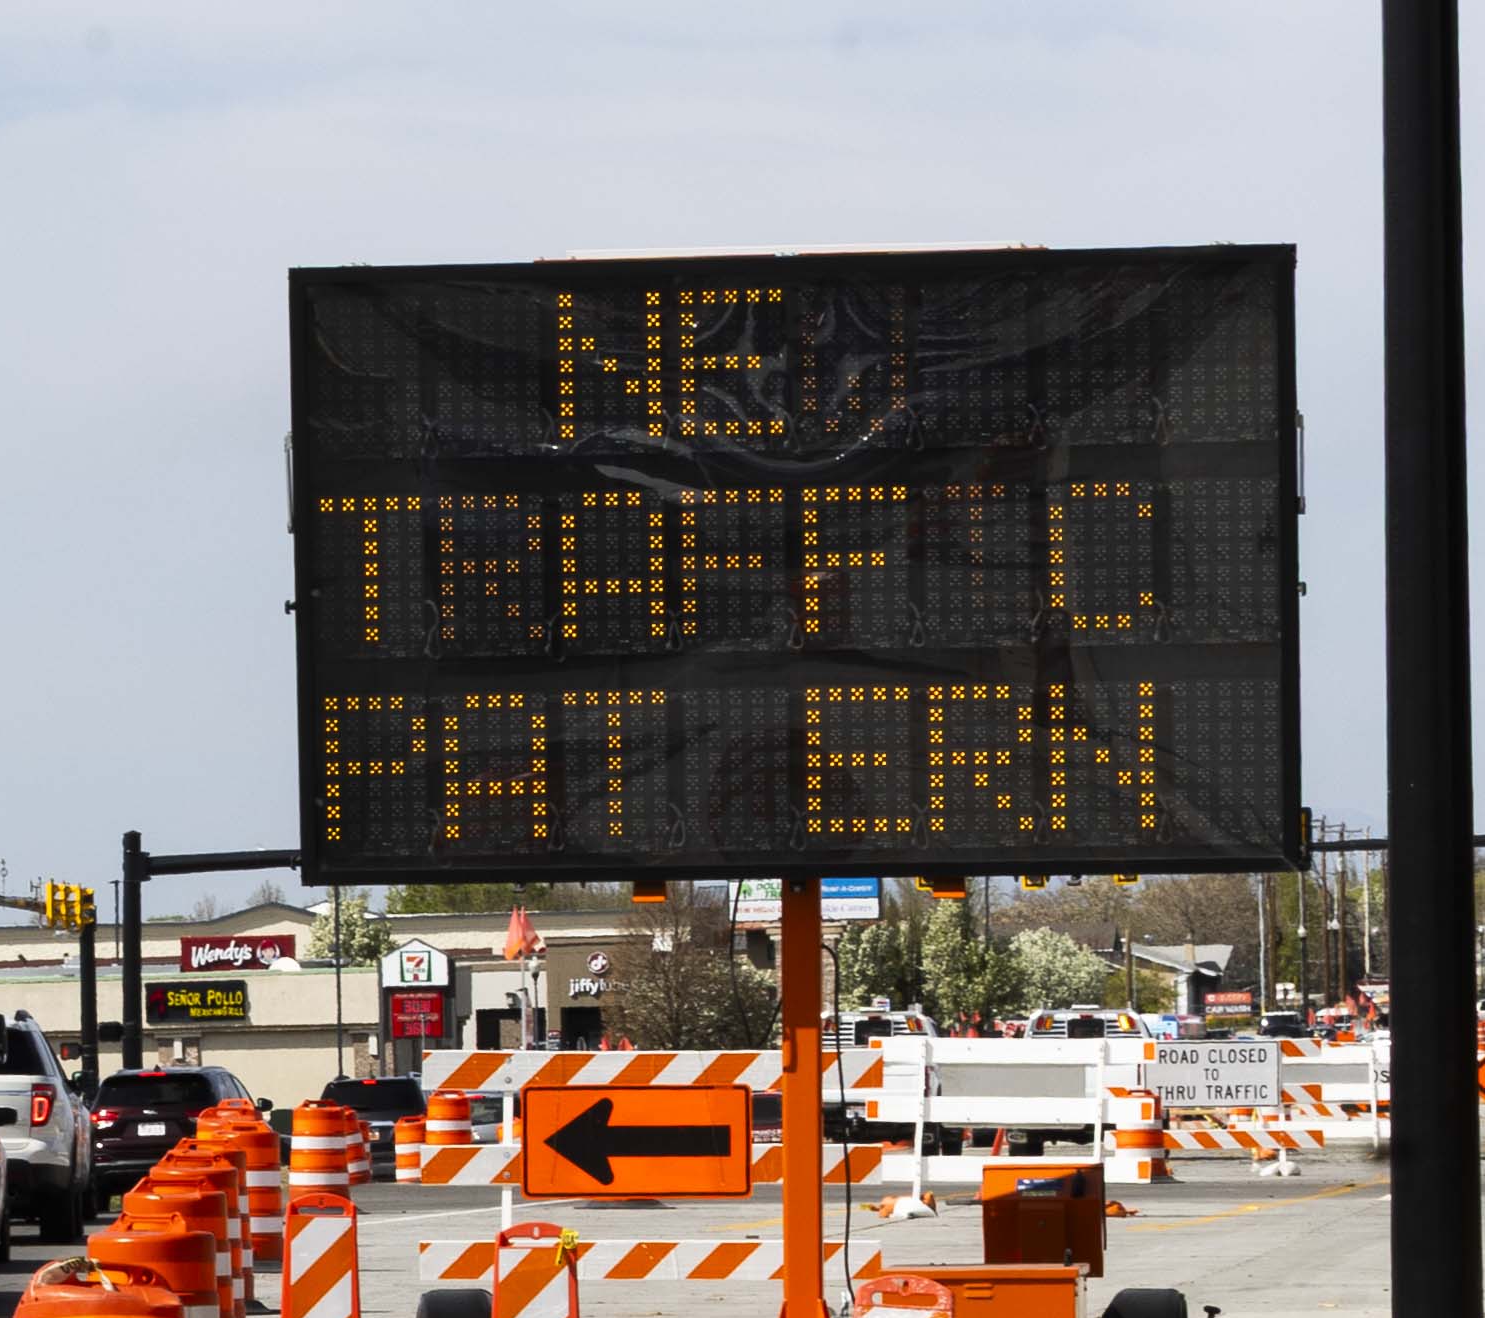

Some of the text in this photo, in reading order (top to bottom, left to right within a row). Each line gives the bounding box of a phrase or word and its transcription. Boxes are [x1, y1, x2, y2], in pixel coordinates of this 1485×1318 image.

[558, 289, 907, 438] NEW
[318, 482, 1153, 643] TRAFFIC
[190, 940, 252, 968] Wendy's
[568, 978, 599, 997] jiffy
[166, 989, 244, 1007] SEÑOR POLLO
[1158, 1048, 1268, 1065] ROAD CLOSED
[1203, 1067, 1220, 1081] TO
[1156, 1084, 1269, 1101] THRU TRAFFIC
